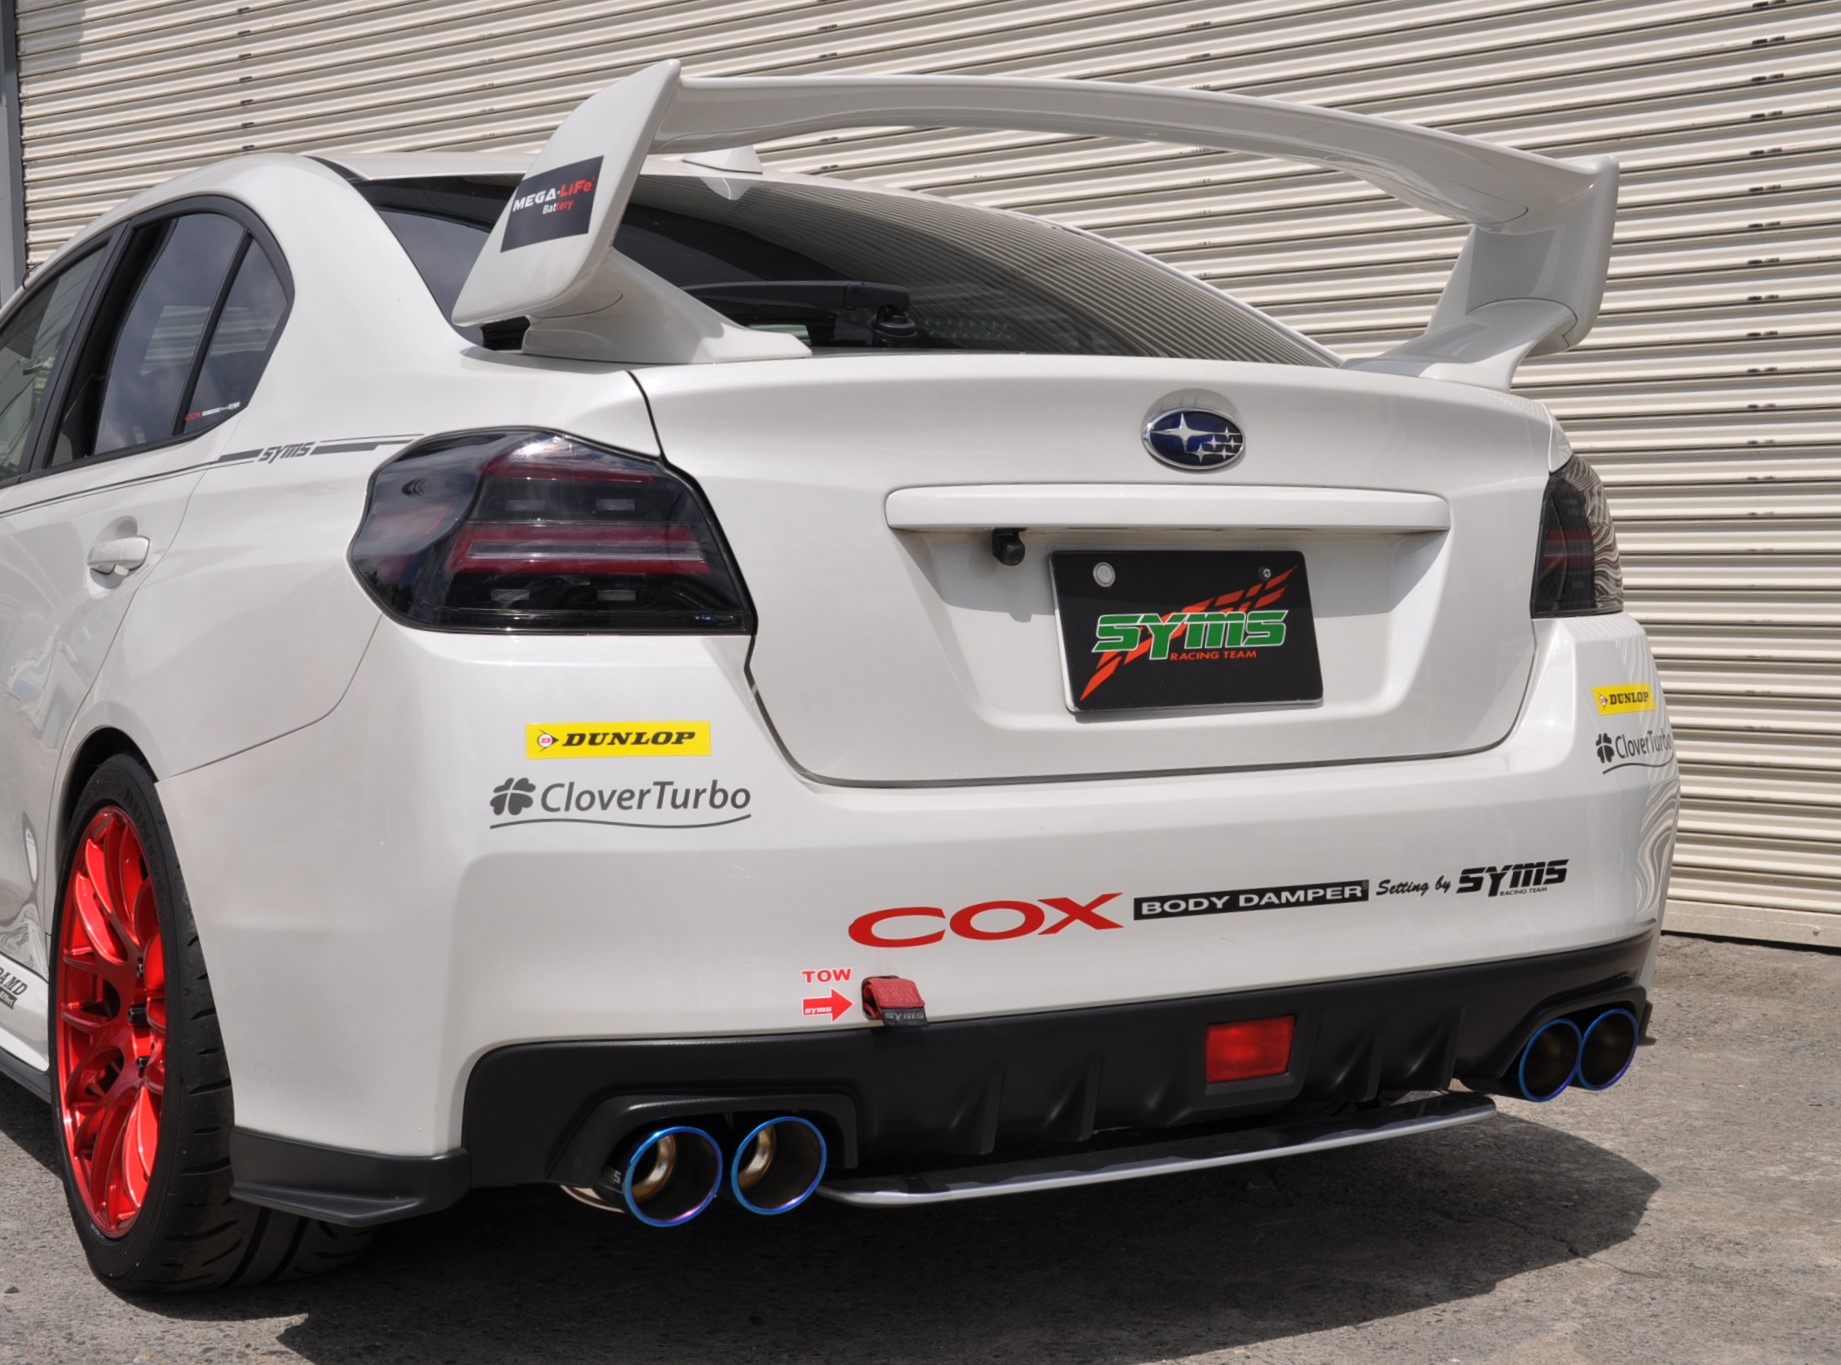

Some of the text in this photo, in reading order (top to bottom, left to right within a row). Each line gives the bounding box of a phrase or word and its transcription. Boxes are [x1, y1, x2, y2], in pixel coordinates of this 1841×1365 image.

[542, 199, 574, 215] Battery
[1170, 649, 1257, 661] RACING TEAM
[1608, 691, 1649, 705] DUNLOP
[562, 731, 696, 747] DUNLOP
[540, 779, 752, 813] CloverTurbo
[1500, 886, 1548, 896] RACING TEAM
[848, 892, 1125, 948] COX
[1141, 895, 1231, 915] BODY
[1238, 884, 1363, 908] DAMPER
[1376, 879, 1430, 896] Setting
[1435, 875, 1452, 891] by
[802, 968, 852, 983] TOW
